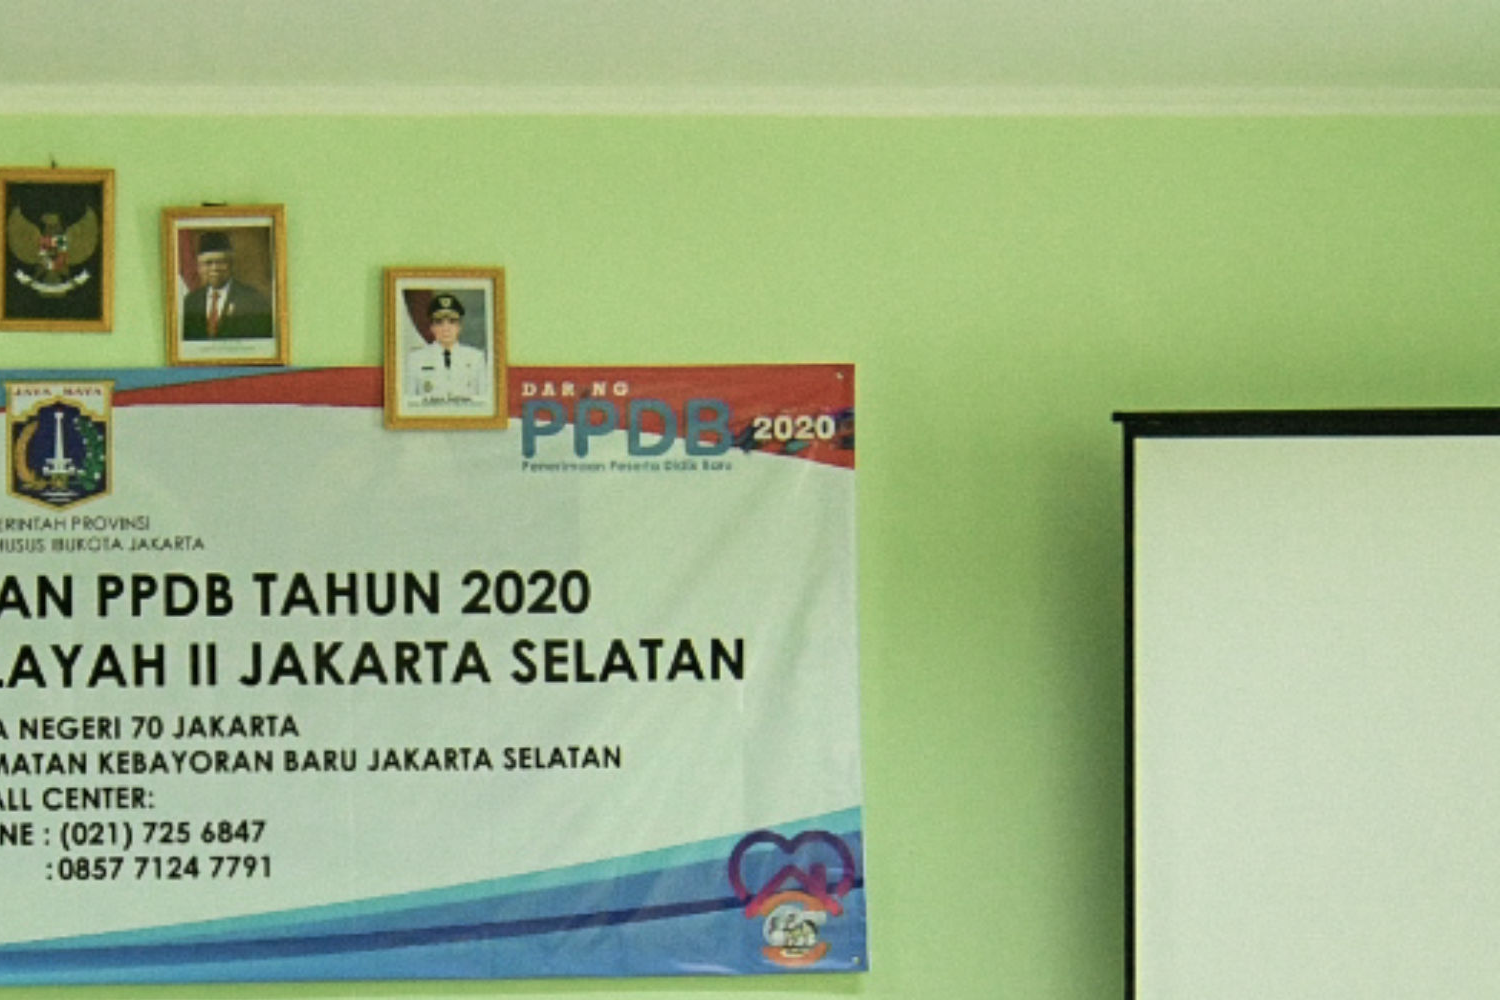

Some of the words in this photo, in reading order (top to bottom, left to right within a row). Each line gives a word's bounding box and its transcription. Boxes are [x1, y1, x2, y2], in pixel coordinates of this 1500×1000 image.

[521, 397, 733, 459] PPDB
[752, 413, 837, 442] 2020
[71, 515, 150, 531] PROVINSI
[51, 537, 124, 552] IBUKOTA
[129, 535, 205, 552] JAKARTA
[97, 572, 233, 618] PPDB
[252, 571, 440, 617] TAHUN
[461, 569, 591, 615] 2020
[189, 642, 217, 686] II
[239, 640, 492, 687] JAKARTA
[511, 638, 744, 684] SELATAN
[19, 716, 121, 740] NEGERI
[131, 715, 164, 740] 70
[173, 715, 300, 739] JAKARTA
[99, 750, 273, 775] KEBAYORAN
[284, 749, 357, 772] BARU
[368, 747, 493, 772] JAKARTA
[503, 746, 621, 771] SELATAN
[42, 786, 154, 811] CENTER:
[60, 821, 133, 852] (021)
[142, 821, 191, 844] 725
[200, 819, 266, 844] 6847
[134, 855, 200, 880] 7124
[209, 855, 271, 878] 7791
